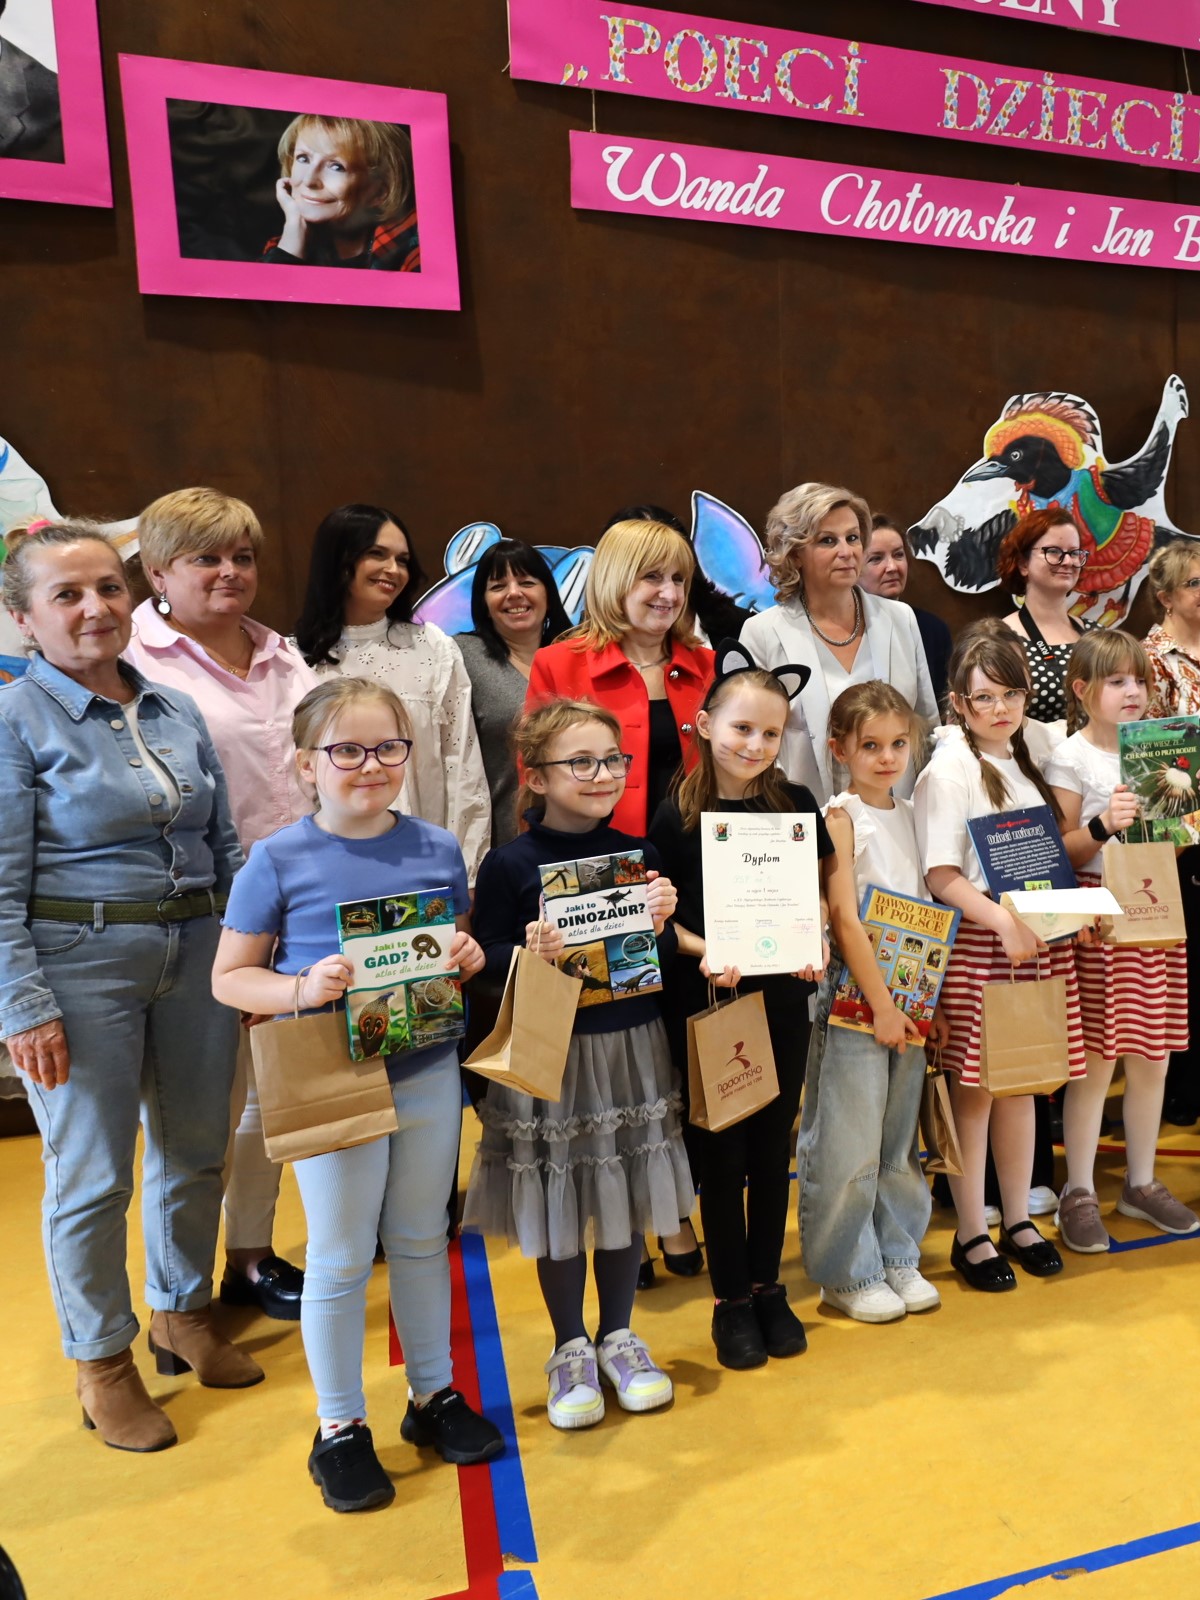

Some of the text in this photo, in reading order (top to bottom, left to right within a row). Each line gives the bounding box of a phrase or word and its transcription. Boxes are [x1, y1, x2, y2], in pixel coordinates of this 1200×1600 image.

[601, 145, 785, 219] Wanda
[820, 172, 1033, 246] Chotomska
[1054, 207, 1076, 249] i
[1092, 206, 1153, 257] Jan
[1155, 749, 1161, 757] O
[1161, 745, 1197, 756] PRZYRODZIE
[986, 829, 1013, 845] Dzieci
[741, 852, 781, 867] Dyplom
[557, 902, 646, 929] DINOZAUR?
[565, 902, 597, 913] Jaki to
[876, 894, 950, 921] DAWNO TEMU
[875, 903, 888, 917] W
[890, 908, 944, 933] POLSCE
[568, 920, 625, 938] atlas dla dzieci
[373, 941, 408, 953] Jaki to
[364, 950, 410, 969] GAD?
[375, 960, 438, 979] atlas dla dzieci
[616, 1339, 637, 1351] FILA
[564, 1348, 587, 1360] FILA
